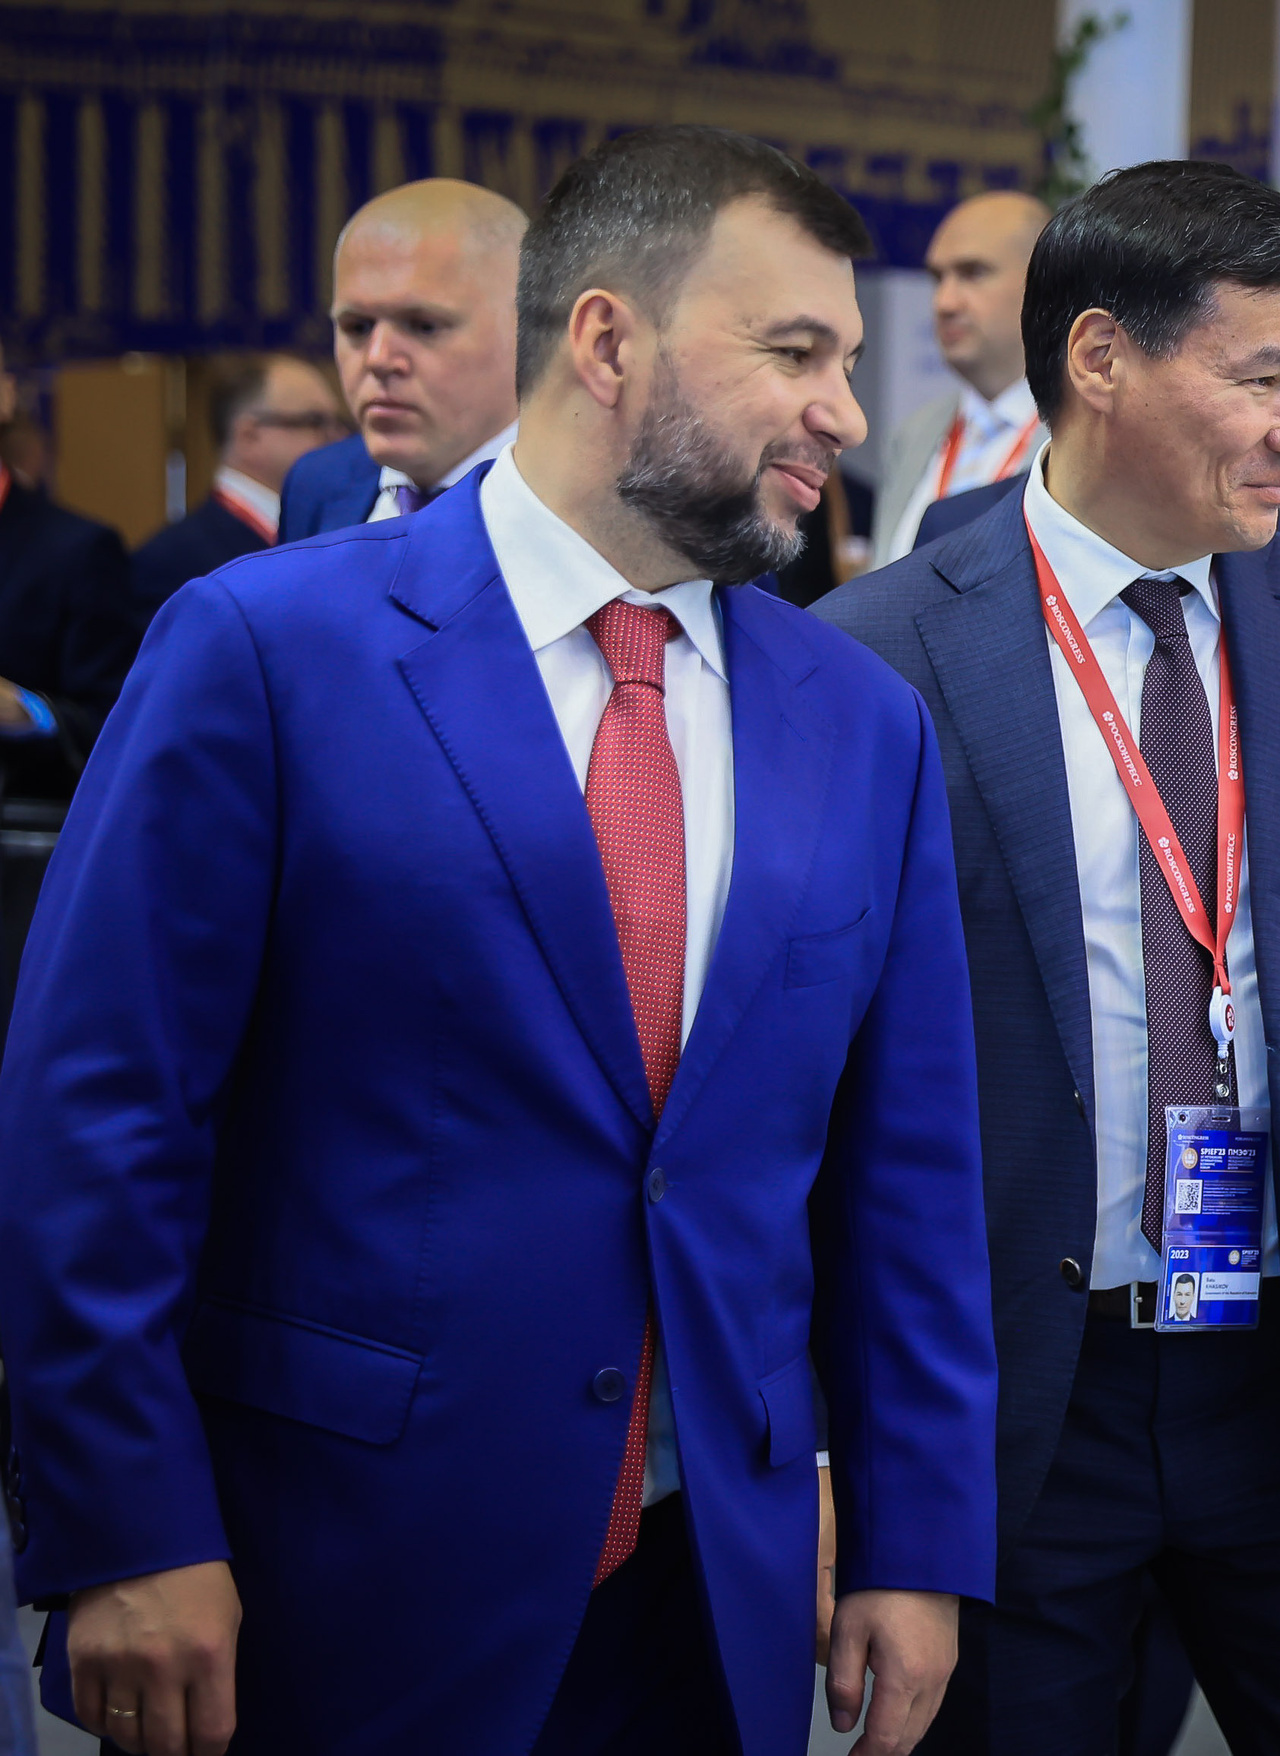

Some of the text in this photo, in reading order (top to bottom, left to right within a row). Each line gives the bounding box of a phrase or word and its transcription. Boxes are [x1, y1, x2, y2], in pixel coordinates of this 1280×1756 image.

[1051, 604, 1086, 664] ROSCONGRESS
[1107, 721, 1142, 787] РОСКОНГРЕСС
[1163, 847, 1197, 913] ROSCONGRESS
[1226, 832, 1236, 902] РОСКОНГРЕСС
[1170, 1249, 1190, 1259] 2023
